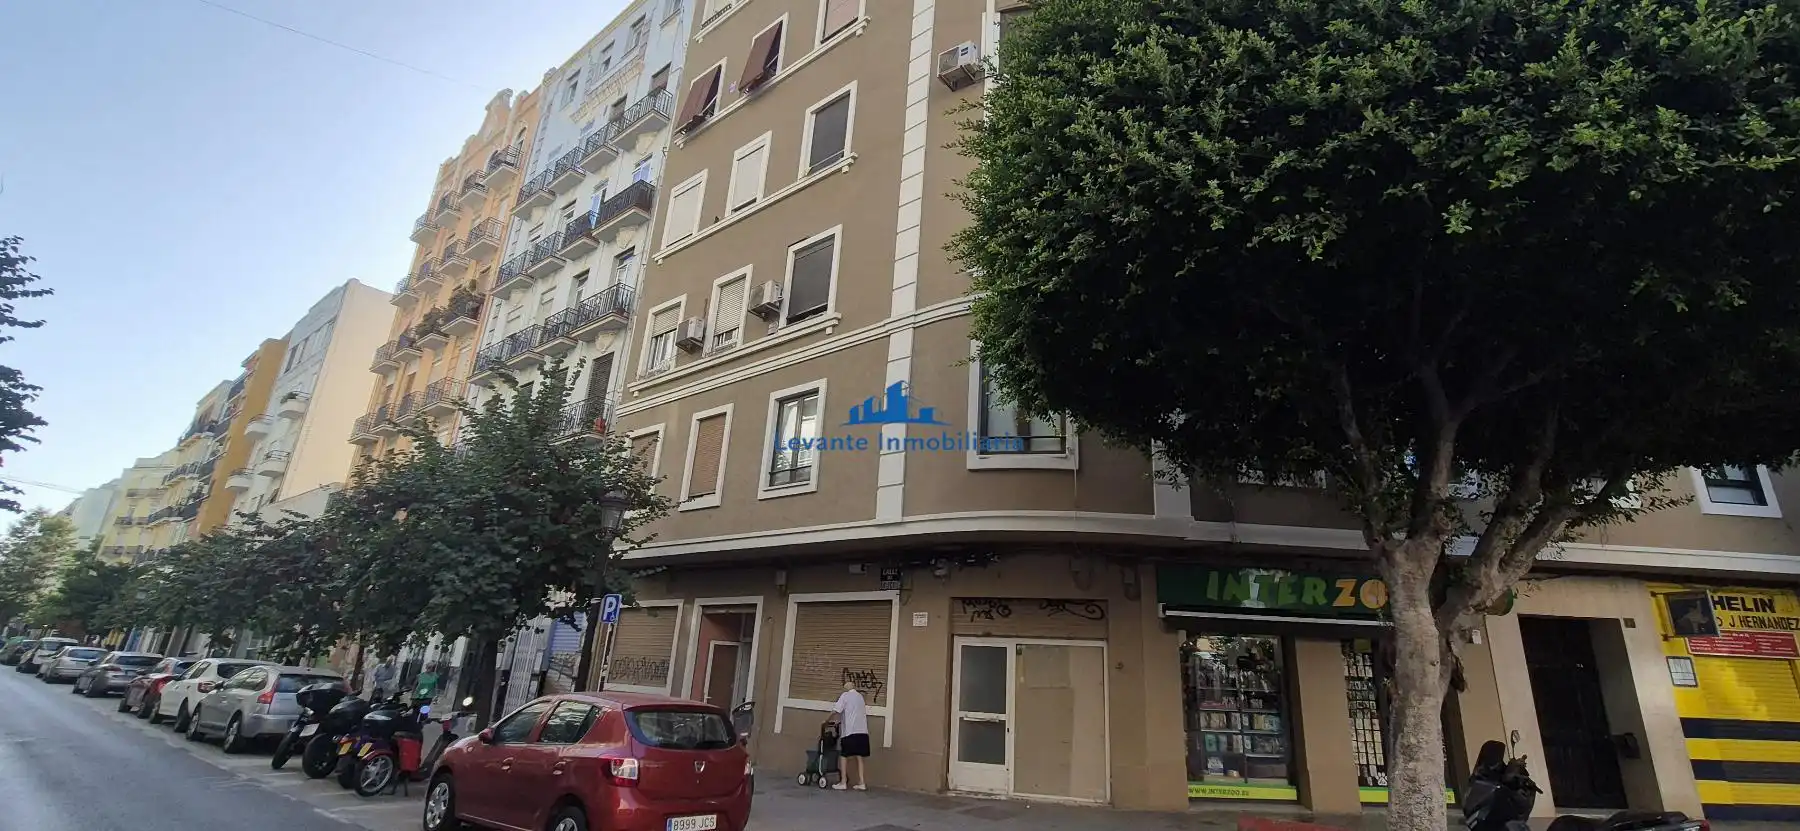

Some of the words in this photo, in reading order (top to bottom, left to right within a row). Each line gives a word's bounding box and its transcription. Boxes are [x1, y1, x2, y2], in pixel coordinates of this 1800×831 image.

[1206, 571, 1389, 609] INTERZO
[602, 597, 617, 620] P
[1711, 596, 1776, 613] HELIN
[674, 819, 696, 831] 8999
[698, 817, 715, 828] JCS
